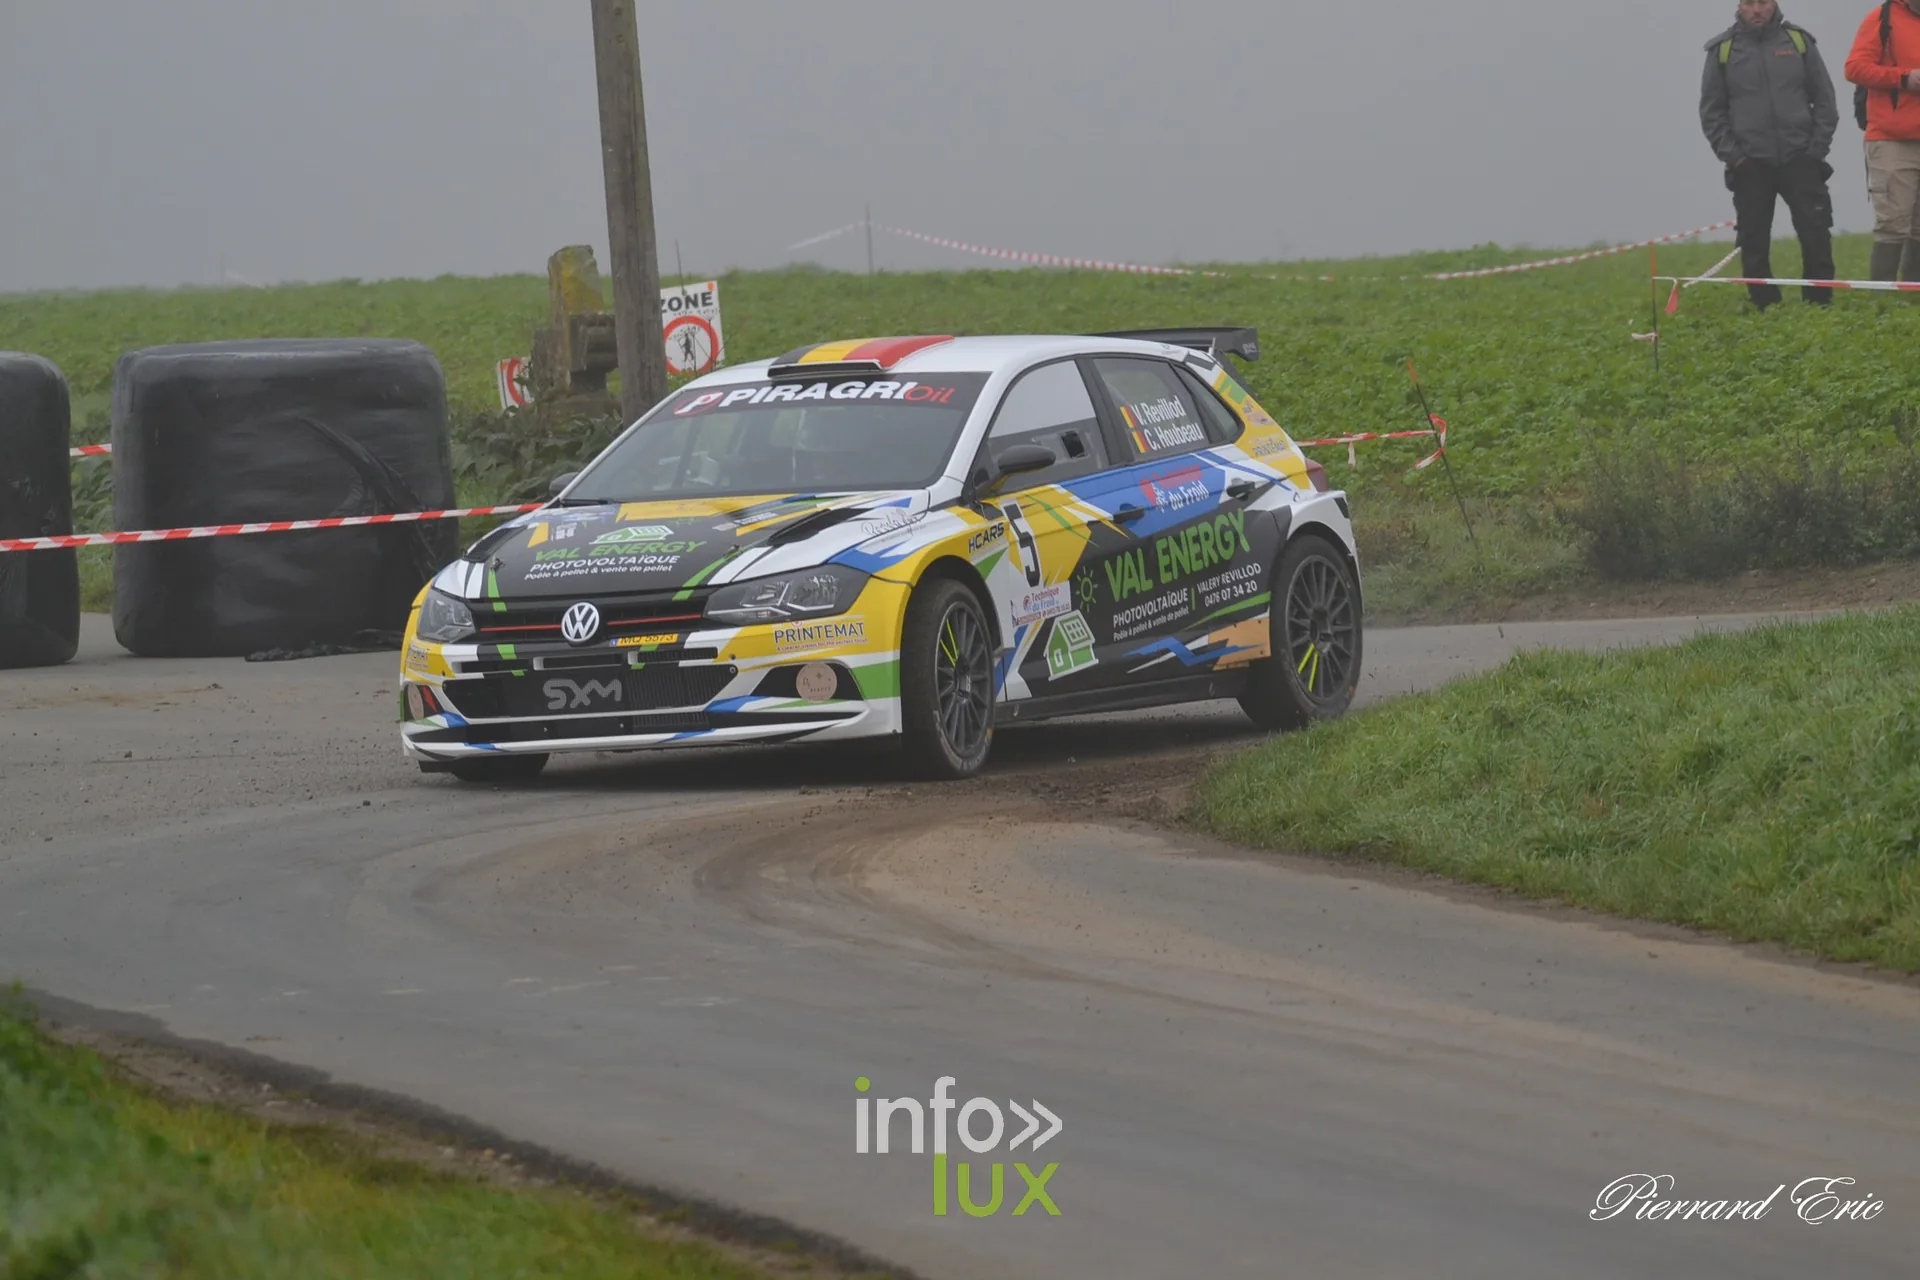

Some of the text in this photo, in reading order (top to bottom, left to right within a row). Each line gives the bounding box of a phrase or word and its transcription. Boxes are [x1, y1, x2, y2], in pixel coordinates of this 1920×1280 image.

[1141, 395, 1186, 424] Revillod
[1155, 422, 1204, 449] Houbeau
[1178, 480, 1209, 505] Froid
[968, 522, 1004, 553] HCARS
[1003, 503, 1040, 588] 5
[535, 541, 707, 562] VAL ENERGY
[1104, 508, 1250, 602] VAL ENERGY
[560, 568, 589, 579] pellet
[643, 565, 673, 574] pellet
[1221, 563, 1261, 584] REVILLOD
[1221, 588, 1231, 600] 07
[1232, 584, 1244, 597] 34
[1245, 580, 1257, 593] 20
[774, 622, 865, 644] PRINTEMAT
[543, 678, 622, 710] SXM
